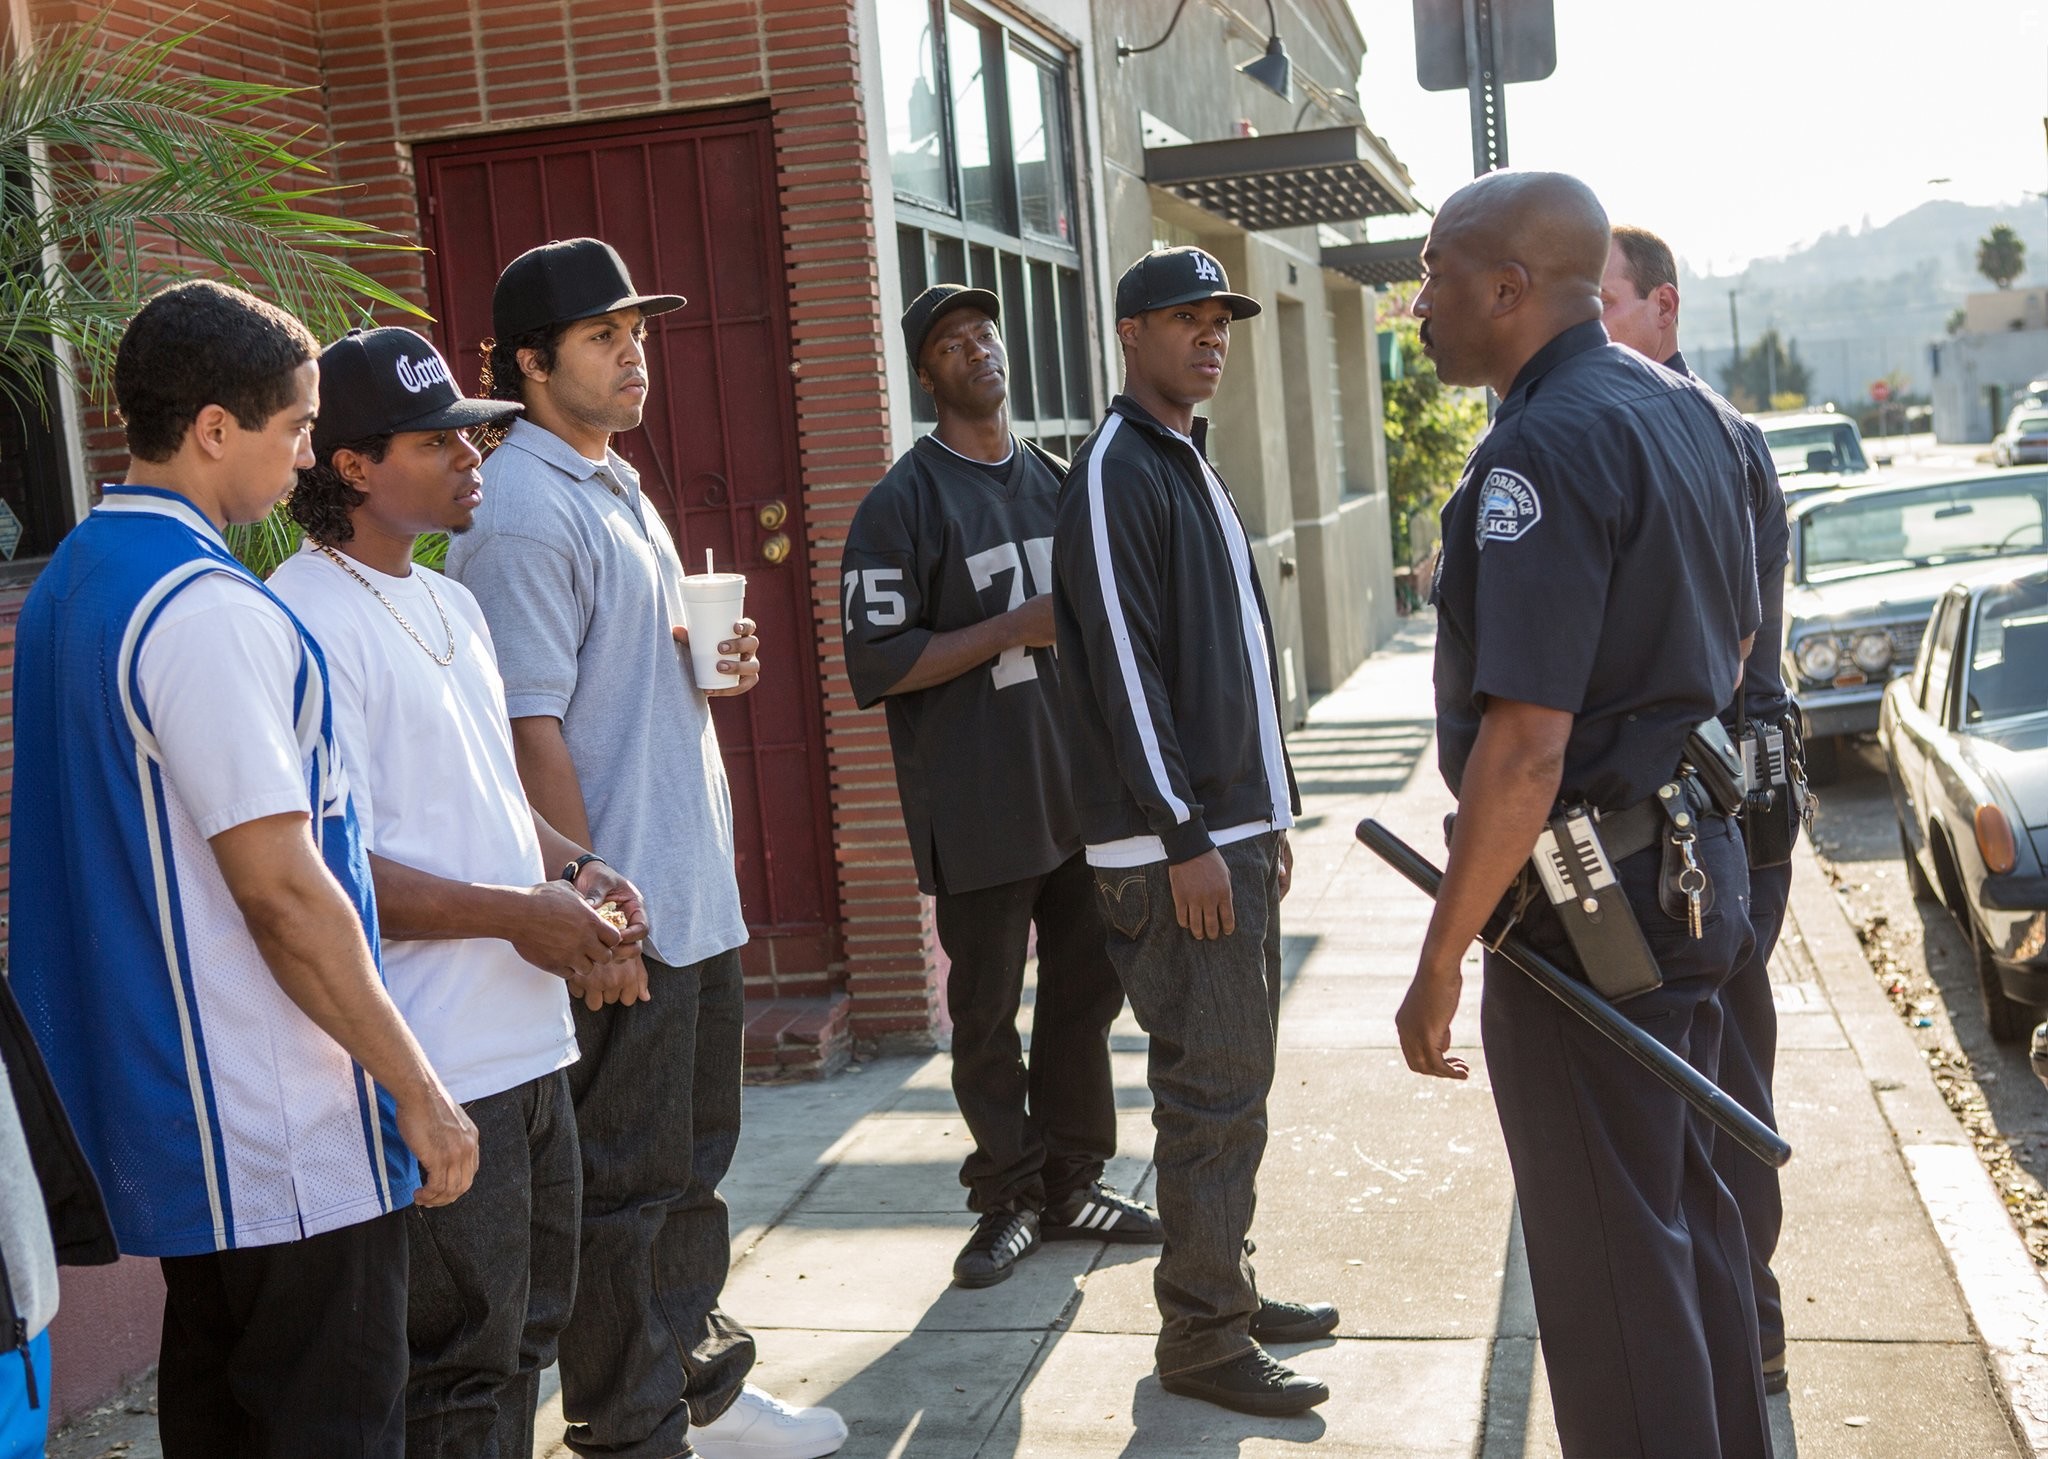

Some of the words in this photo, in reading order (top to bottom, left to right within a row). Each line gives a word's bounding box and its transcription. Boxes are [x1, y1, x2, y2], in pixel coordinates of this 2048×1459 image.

[1189, 251, 1219, 282] LA
[396, 354, 449, 393] Com
[1489, 473, 1535, 516] ORRANCE
[844, 568, 906, 635] 75
